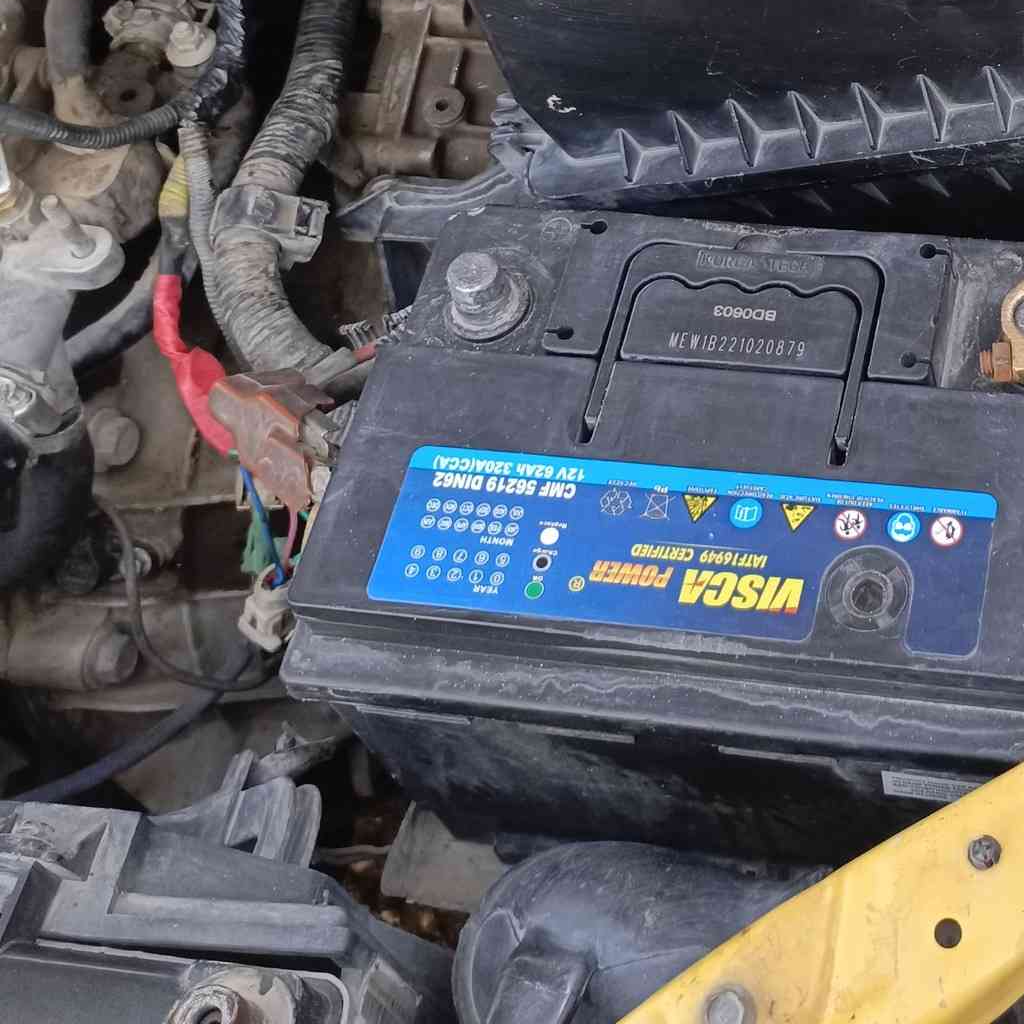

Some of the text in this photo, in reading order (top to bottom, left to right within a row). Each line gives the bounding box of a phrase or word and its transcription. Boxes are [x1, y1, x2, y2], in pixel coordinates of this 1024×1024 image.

[713, 305, 777, 322] BD0603
[433, 455, 585, 482] 12V 62Ah 320A(CCA)
[432, 471, 577, 499] CMF 56219 DIN62
[480, 535, 514, 546] MONTH
[630, 543, 769, 569] IATF16949 CERTIFIED
[589, 560, 674, 588] POWER
[473, 584, 499, 594] YEAR
[678, 568, 804, 614] VISCA
